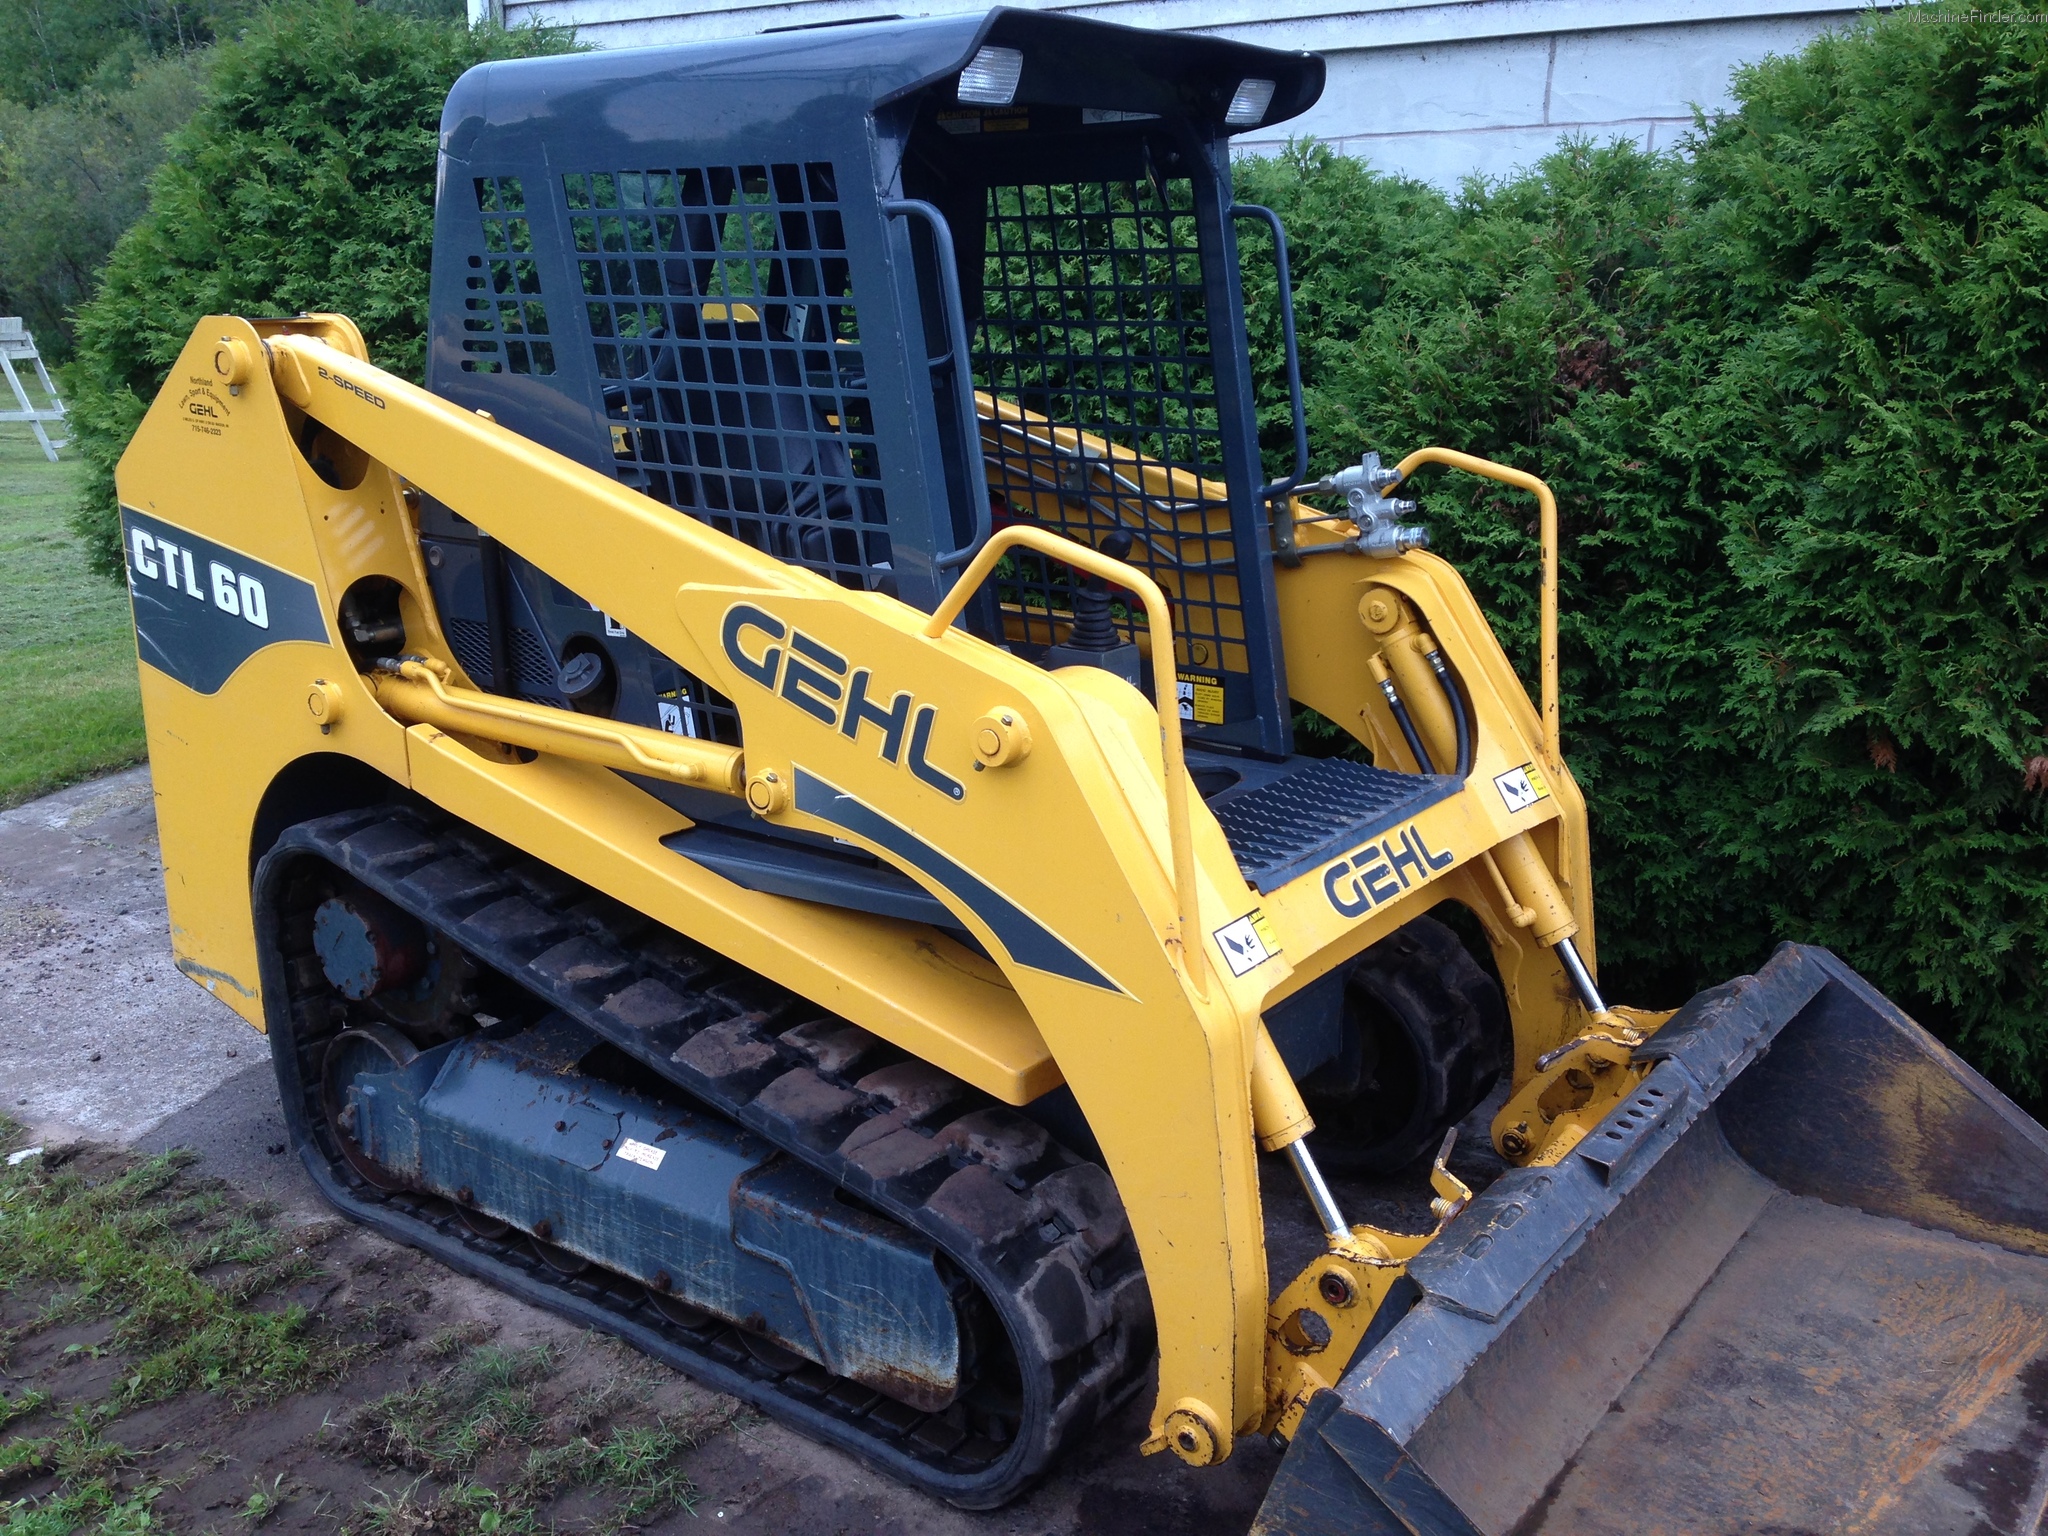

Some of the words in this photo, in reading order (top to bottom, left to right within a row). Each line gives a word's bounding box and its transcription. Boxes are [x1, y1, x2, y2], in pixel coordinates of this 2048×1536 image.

[189, 402, 218, 419] GEHL
[318, 366, 386, 410] 2-SPEED
[130, 525, 205, 602] CTL
[208, 560, 270, 631] 60
[722, 604, 966, 802] GEHL
[1177, 672, 1218, 686] WARNING
[1323, 825, 1454, 918] GEHL
